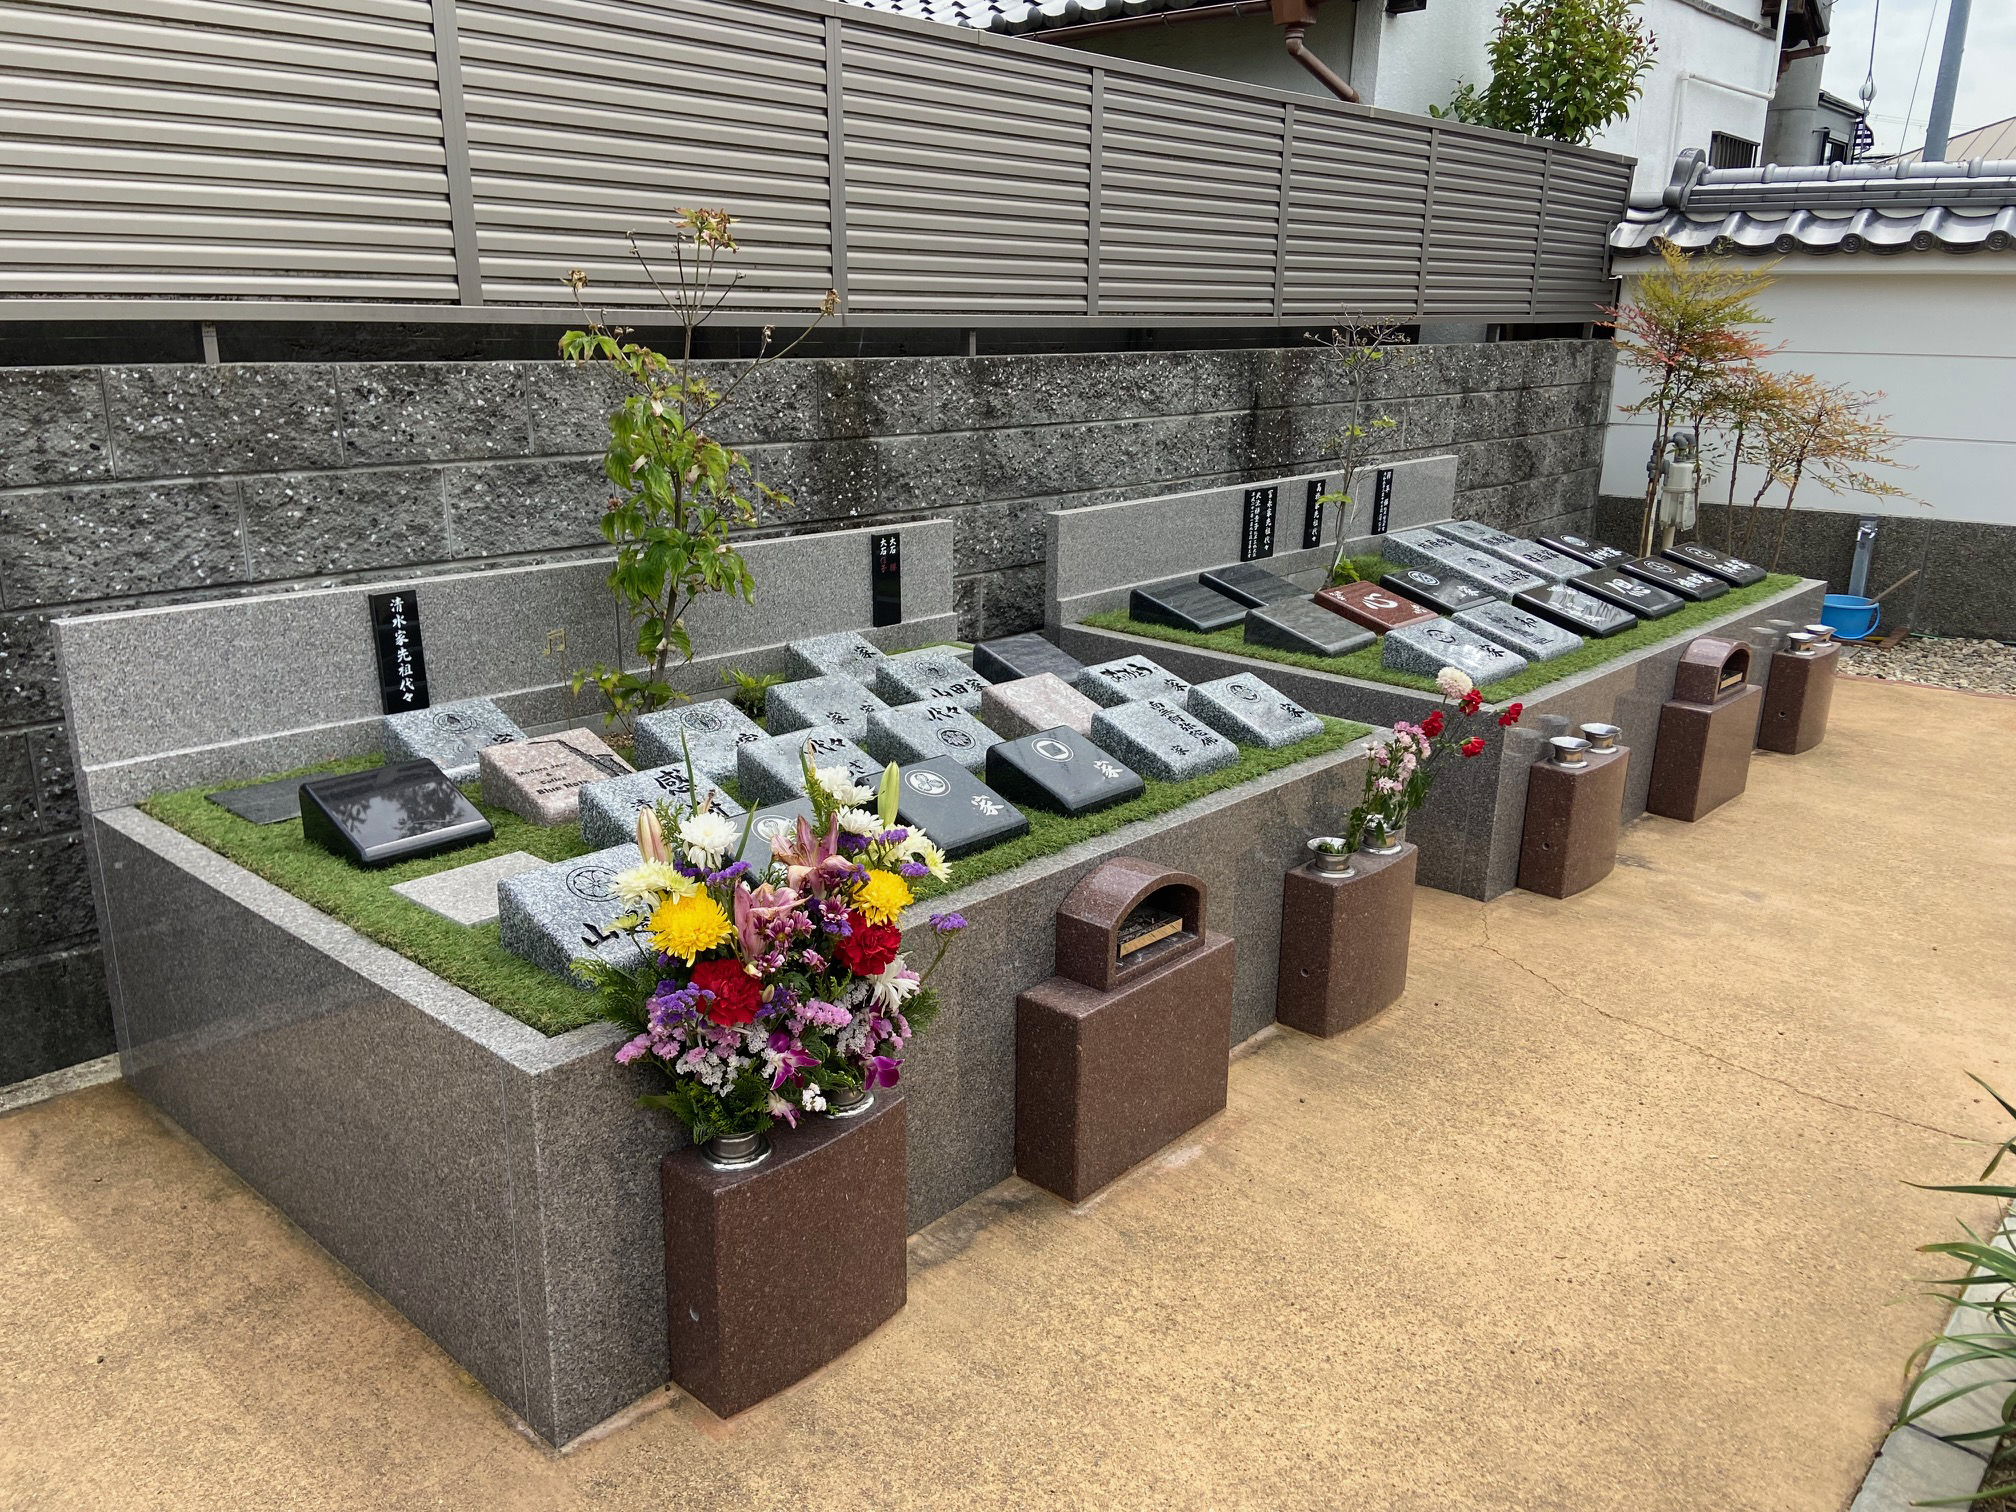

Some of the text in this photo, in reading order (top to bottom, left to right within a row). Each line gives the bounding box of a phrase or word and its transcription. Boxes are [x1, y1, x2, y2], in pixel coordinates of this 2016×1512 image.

[1362, 593, 1398, 609] 心
[390, 596, 415, 702] 清水家先祖代々
[854, 646, 876, 659] 家
[931, 679, 988, 698] 山田家
[1164, 679, 1188, 692] 家
[826, 711, 850, 725] 家
[927, 705, 962, 721] 代々
[1280, 703, 1305, 718] 家
[1093, 761, 1123, 779] 家
[536, 786, 562, 795] Blue
[970, 795, 1005, 816] 家
